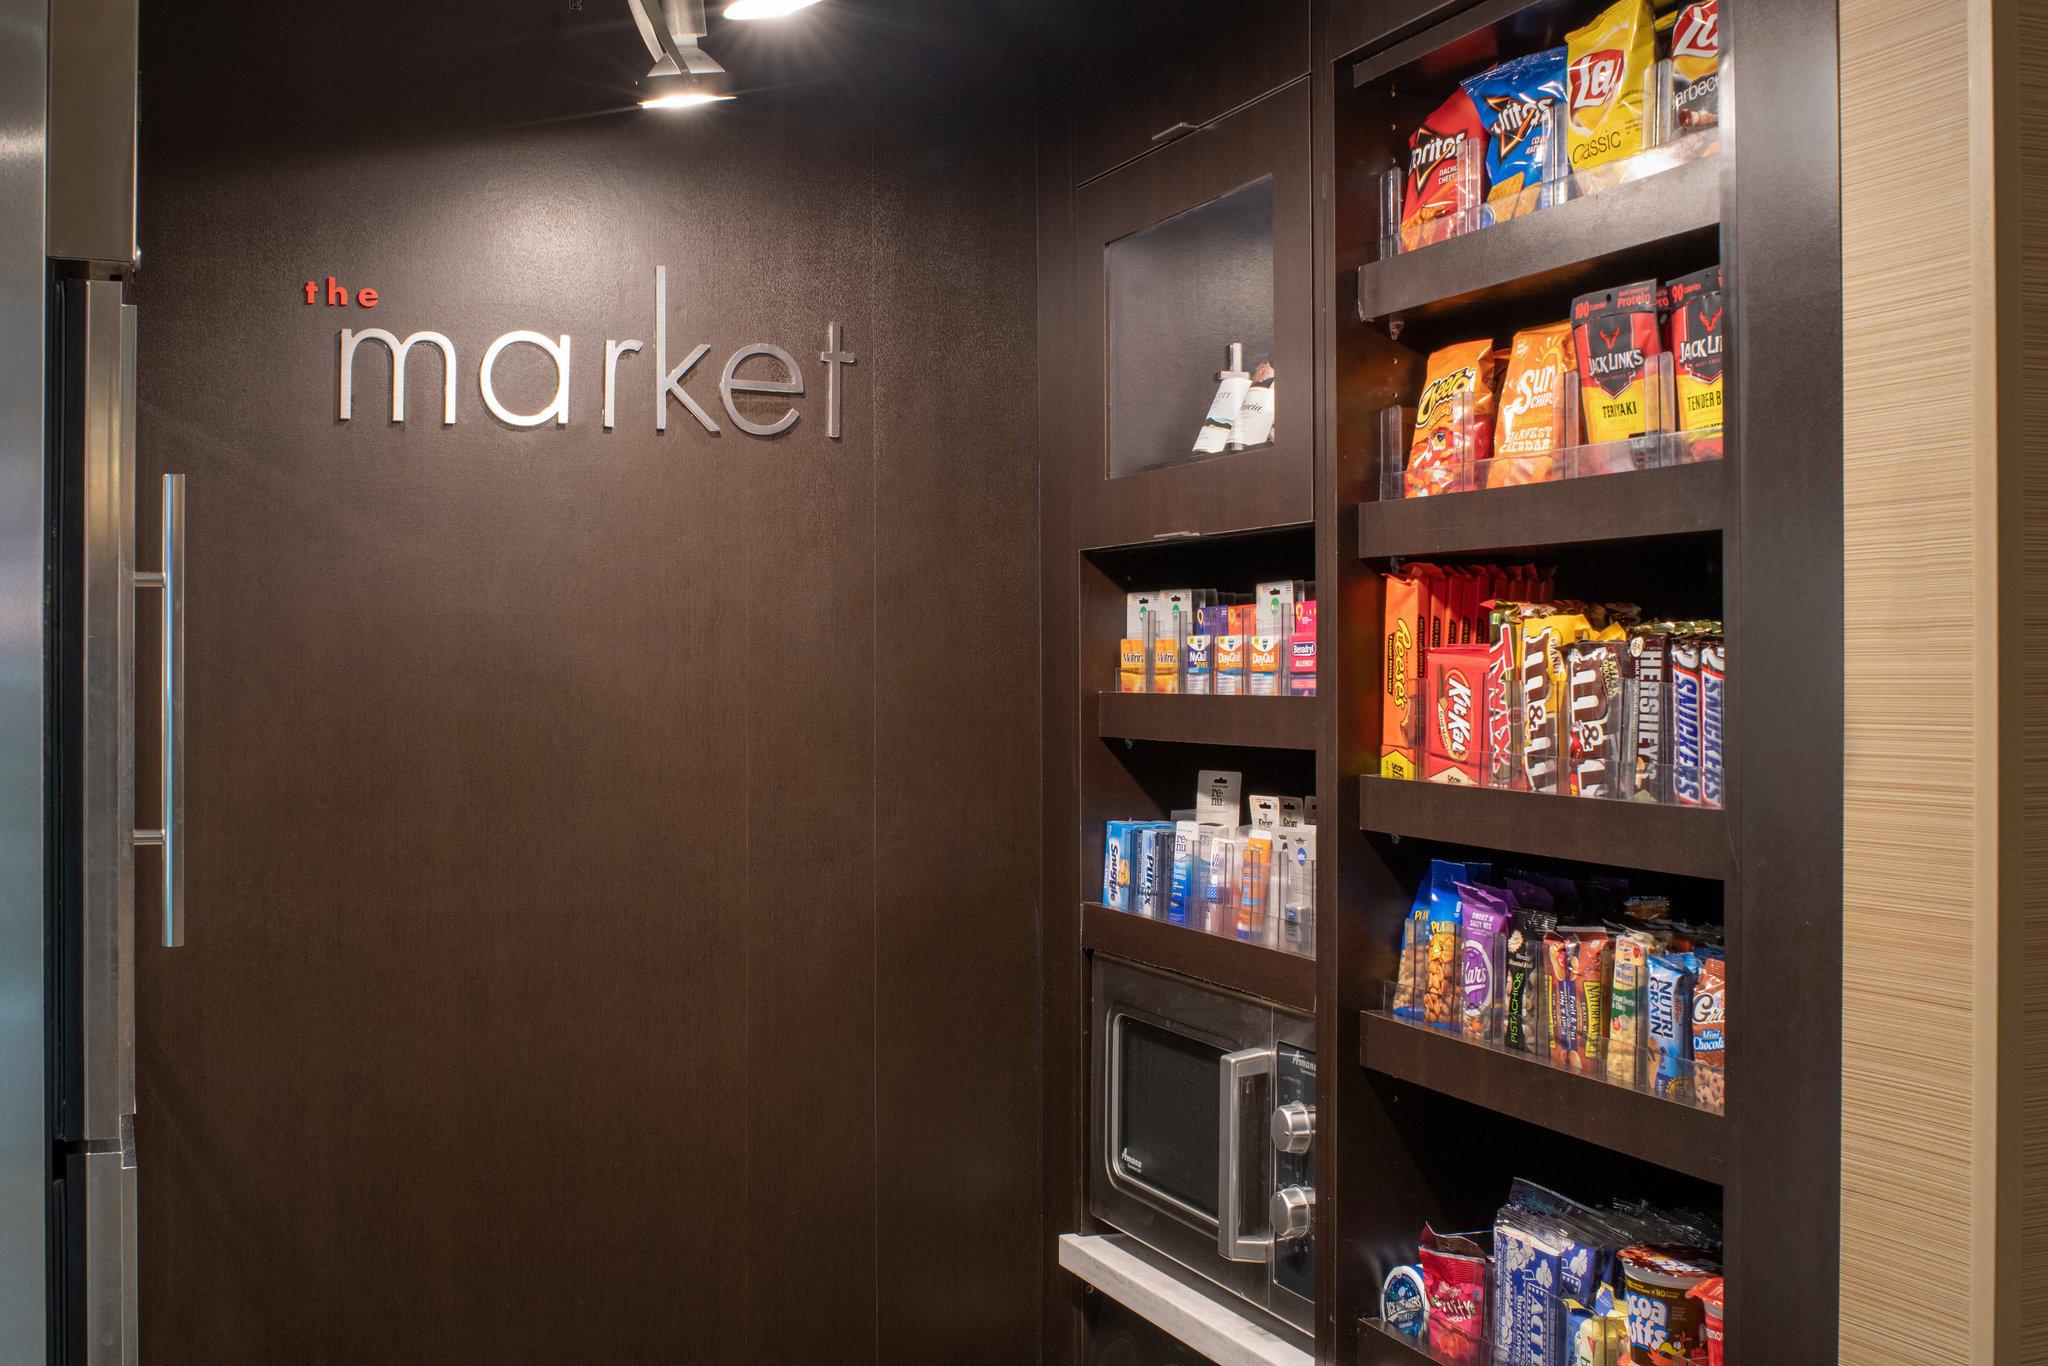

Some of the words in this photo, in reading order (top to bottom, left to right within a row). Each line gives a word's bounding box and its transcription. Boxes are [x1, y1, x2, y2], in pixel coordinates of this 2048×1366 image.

[1409, 132, 1467, 176] oritos
[305, 276, 380, 308] the
[1671, 283, 1684, 303] 90
[339, 265, 855, 439] market
[1589, 355, 1609, 376] JACK
[1680, 339, 1707, 363] JACK
[1602, 400, 1637, 419] TERIYAKI
[1687, 392, 1715, 412] TENDER
[1293, 644, 1314, 656] Benadryl
[1295, 659, 1314, 667] ALLERGY
[1394, 618, 1412, 711] Reese's
[1637, 650, 1662, 780] HERSHEY'S
[1675, 673, 1699, 800] SNICKERS
[1704, 675, 1722, 802] SNICKERS
[1109, 843, 1119, 901] Snuggle
[1510, 972, 1524, 1043] PISTACHIOS
[1650, 976, 1663, 1036] GRAIN
[1659, 980, 1674, 1039] NUTRI
[1702, 1029, 1721, 1040] Mini
[1630, 1316, 1667, 1351] uffs
